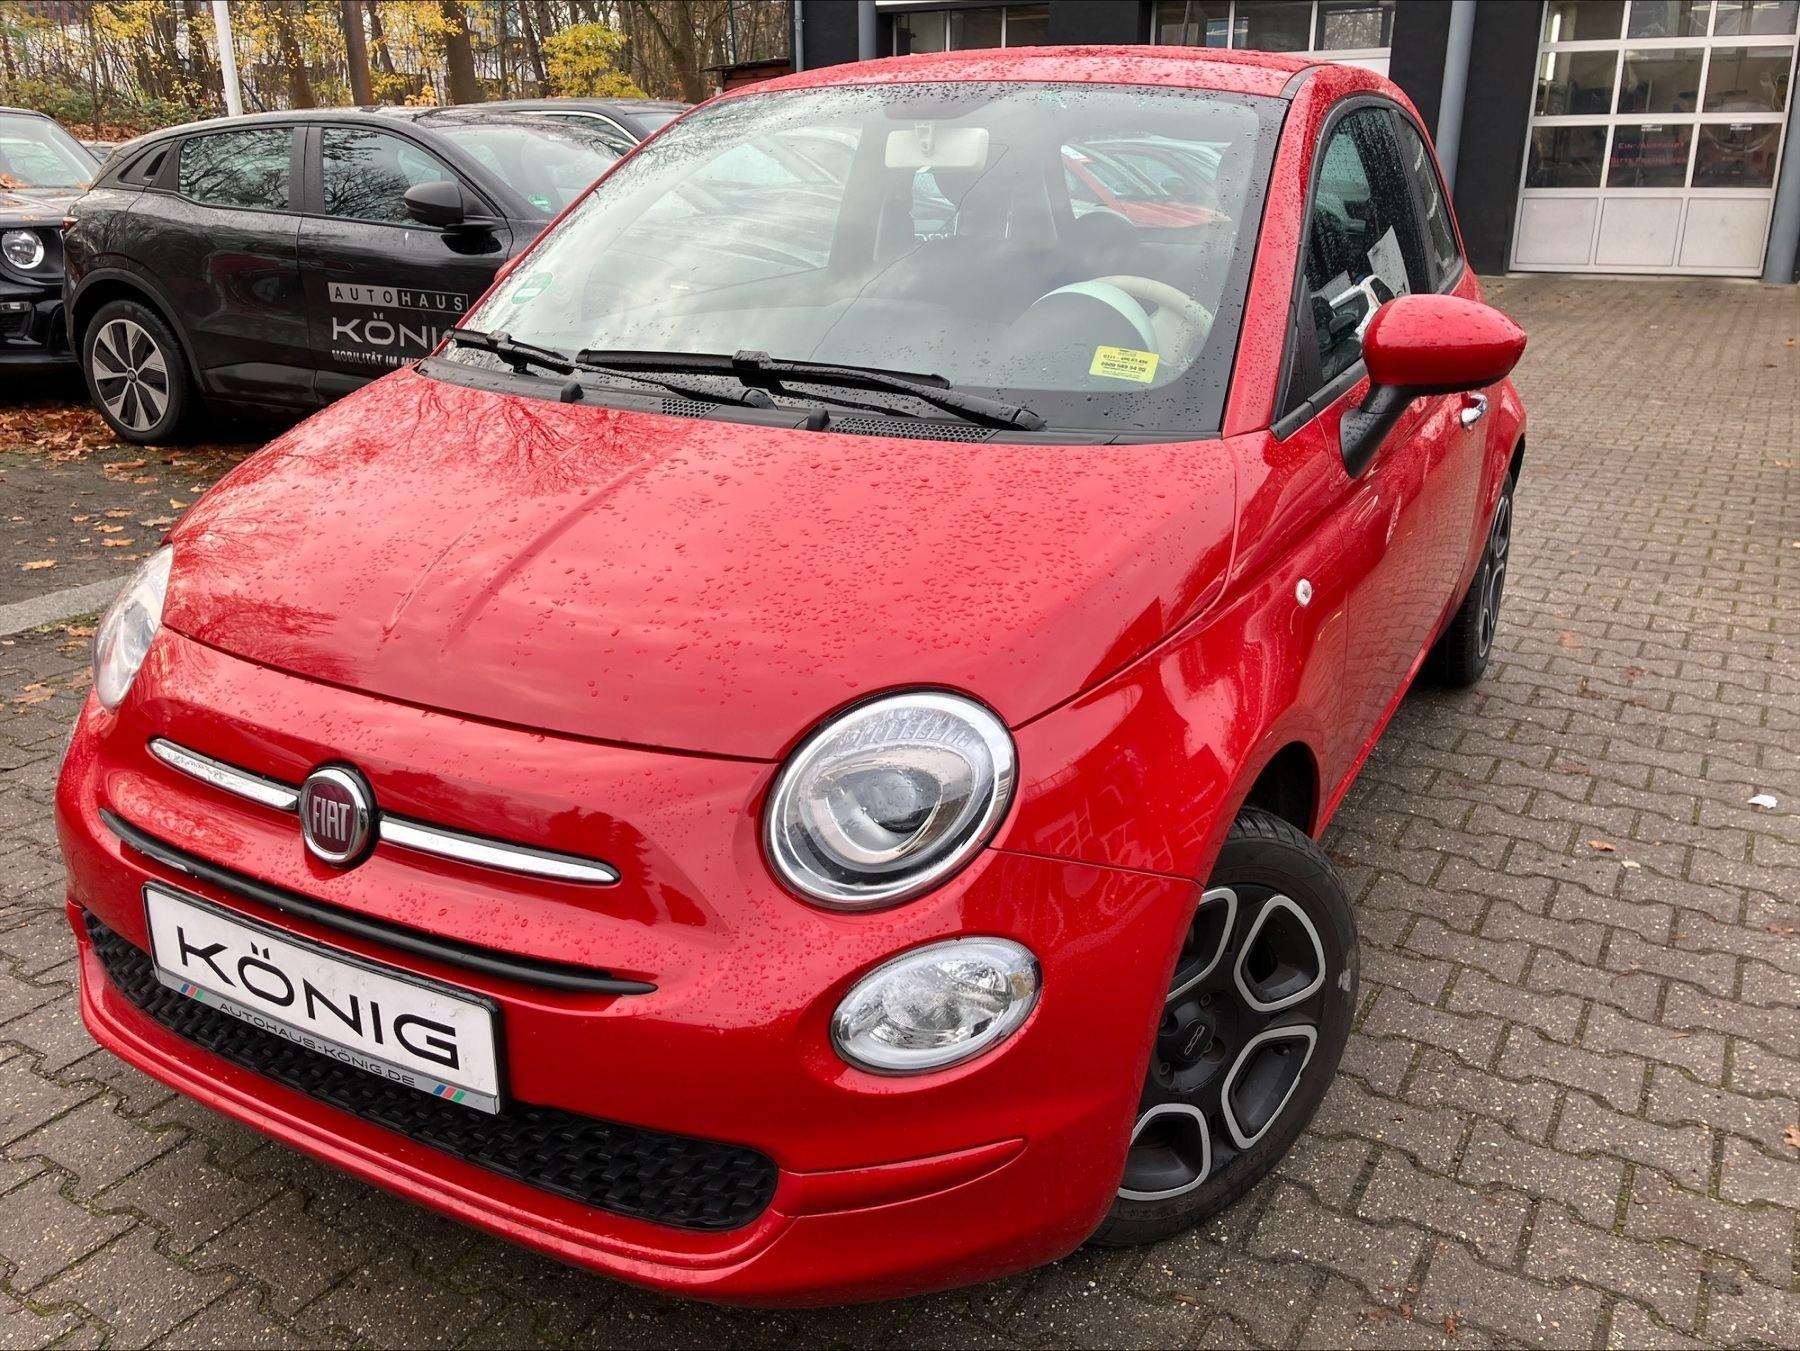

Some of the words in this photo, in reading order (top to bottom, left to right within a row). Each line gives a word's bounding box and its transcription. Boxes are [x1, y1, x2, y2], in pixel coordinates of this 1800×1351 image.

[335, 287, 463, 311] AUTOHAUS
[332, 350, 382, 365] MOBILITÄT
[385, 355, 398, 367] IM
[312, 795, 351, 841] FIAT
[176, 925, 460, 1071] KÖNIG
